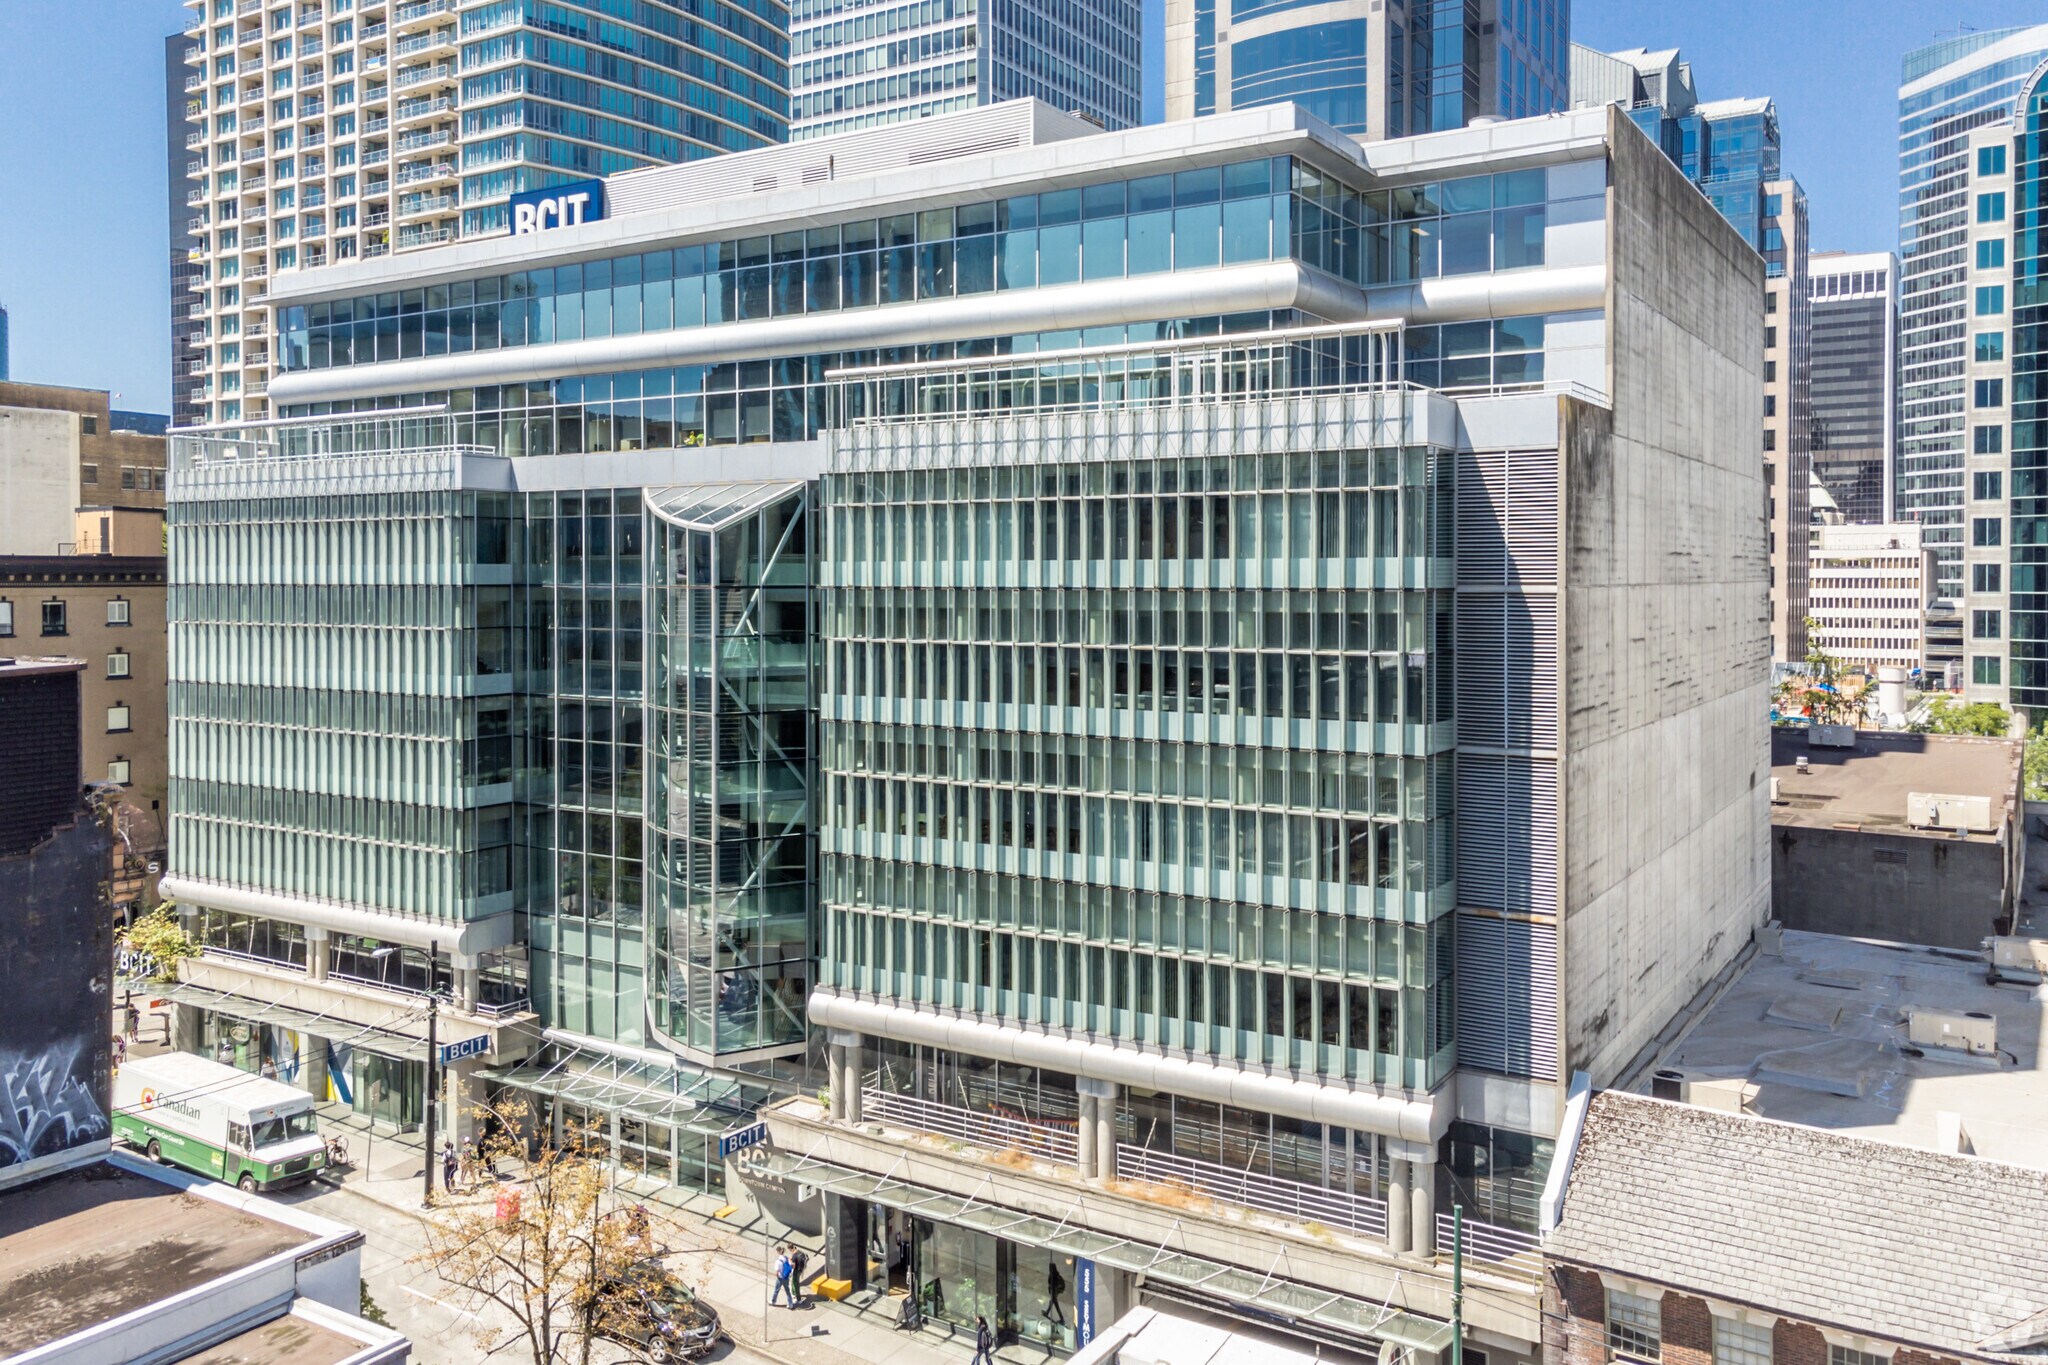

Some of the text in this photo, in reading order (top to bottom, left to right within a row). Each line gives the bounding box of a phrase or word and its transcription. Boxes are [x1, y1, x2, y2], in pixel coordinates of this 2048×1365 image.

[515, 192, 589, 235] BCIT
[121, 951, 154, 975] BCIT
[450, 1037, 484, 1059] BCIT
[156, 1092, 201, 1120] Canadian
[729, 1125, 761, 1153] BCIT
[1082, 1300, 1091, 1346] SEYMOU
